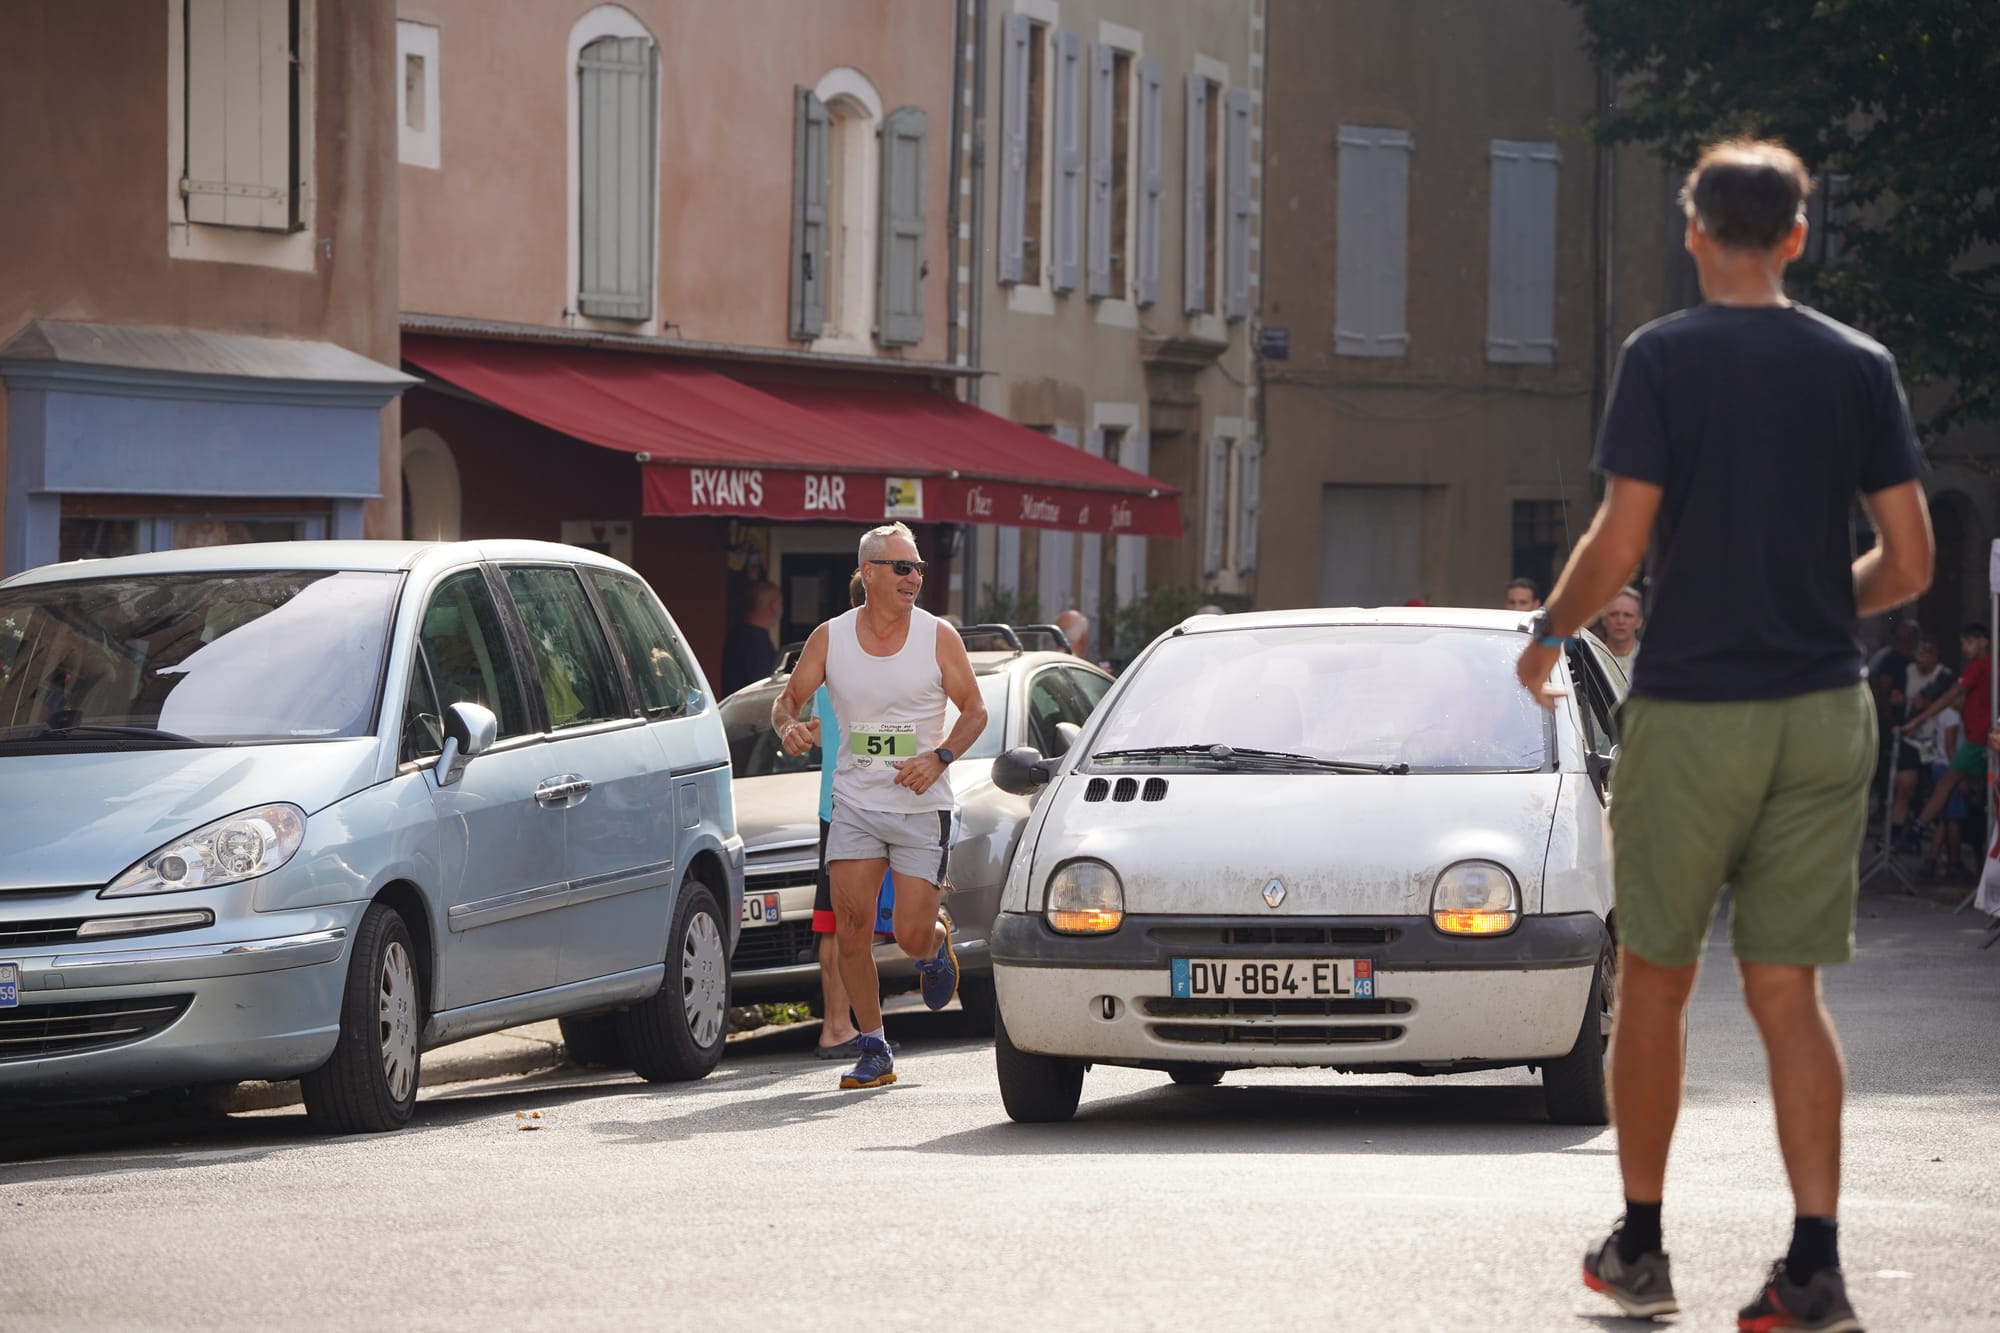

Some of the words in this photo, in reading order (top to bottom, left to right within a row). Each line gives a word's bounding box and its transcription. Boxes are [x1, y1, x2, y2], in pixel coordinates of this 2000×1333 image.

[690, 469, 763, 507] RYAN'S
[804, 475, 845, 510] BAR
[867, 736, 895, 755] 51
[0, 985, 16, 1000] 59
[1177, 982, 1185, 992] F
[1191, 963, 1350, 995] DV-864-EL
[1355, 980, 1372, 996] 48
